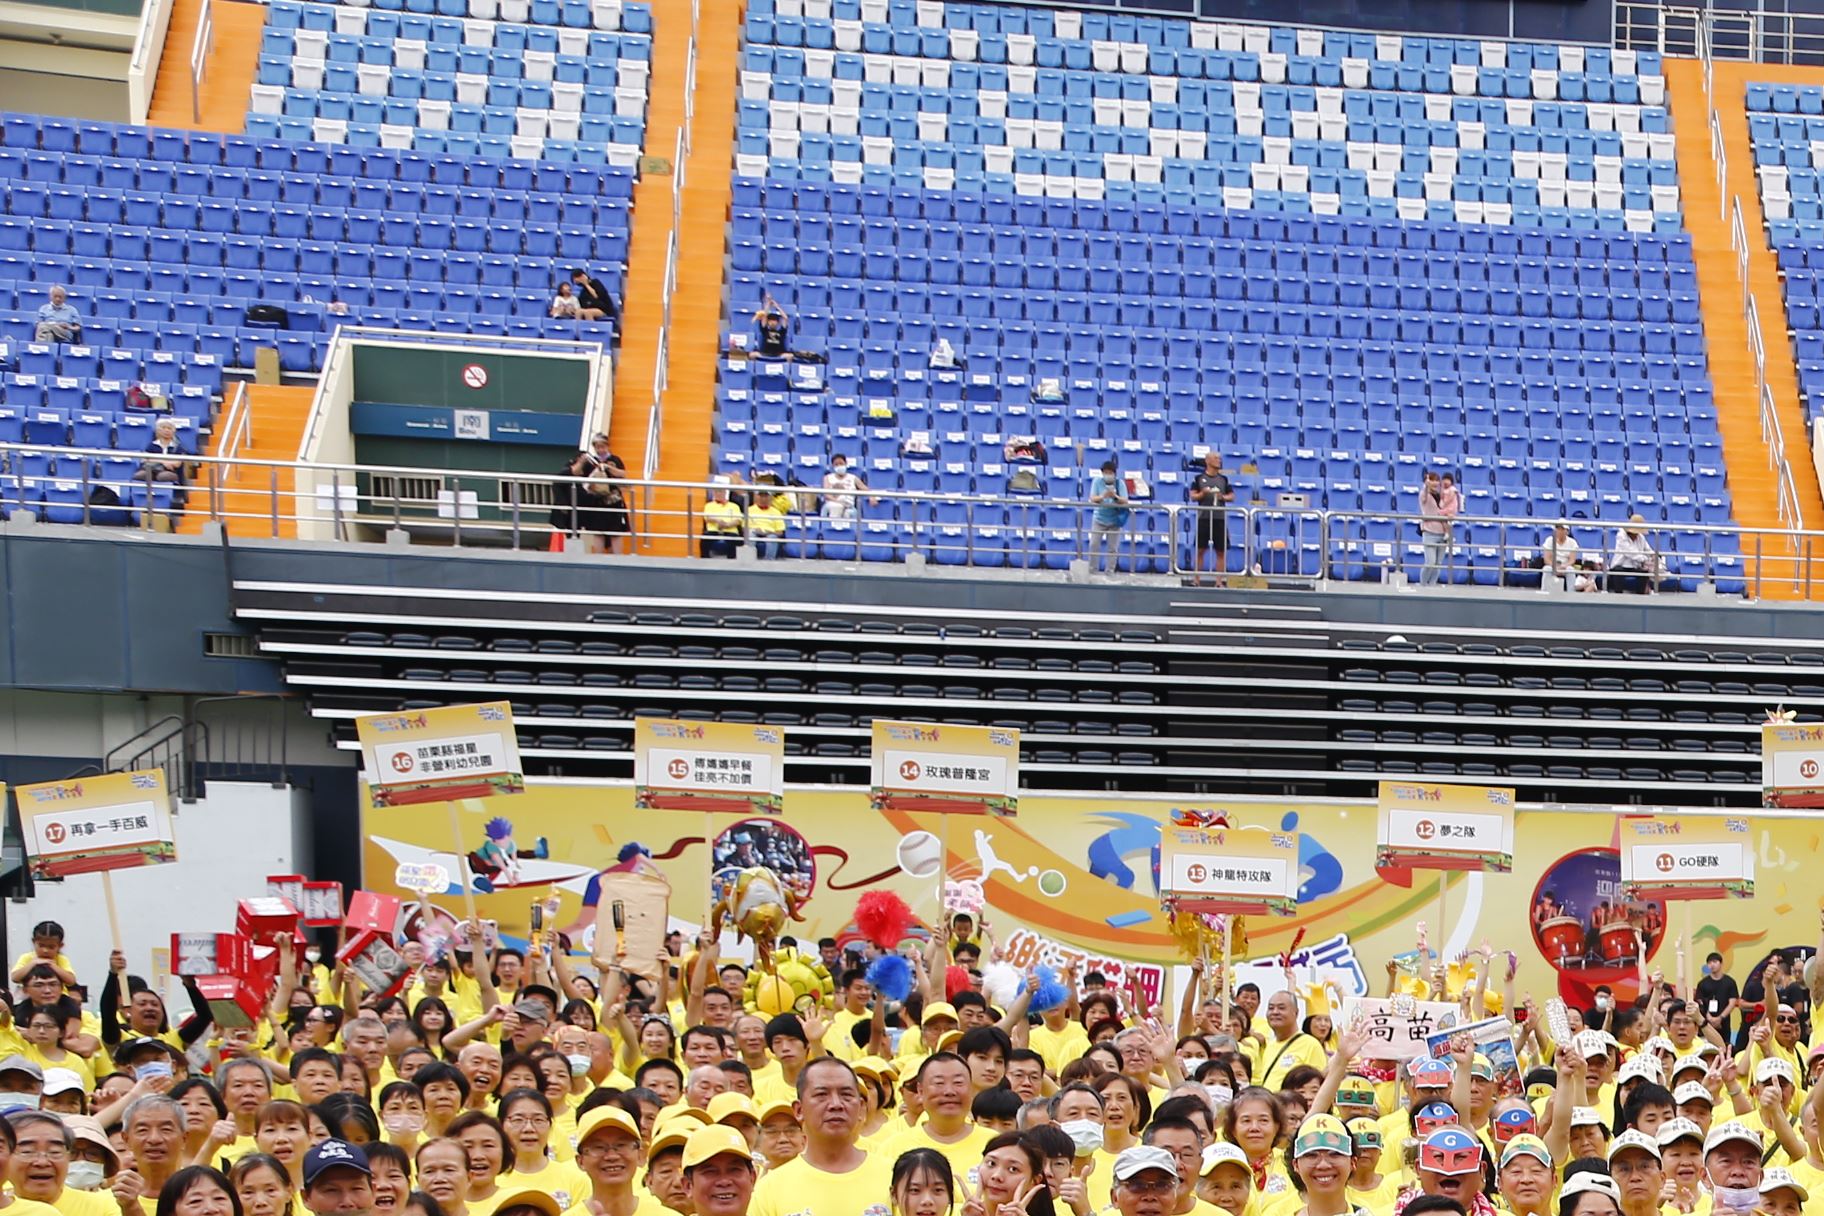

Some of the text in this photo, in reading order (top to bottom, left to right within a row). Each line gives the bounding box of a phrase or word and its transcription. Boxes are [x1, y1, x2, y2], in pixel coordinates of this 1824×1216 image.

[392, 743, 478, 770] 16 苗栗縣福星
[420, 755, 493, 773] 非營利幼兒園
[669, 763, 688, 775] 15
[902, 764, 991, 781] 14 玫瑰普隆宮
[1801, 764, 1817, 775] 10
[47, 815, 149, 840] 17 再拿一手百威
[1418, 824, 1476, 838] 12 夢之隊
[1658, 857, 1673, 869] 11
[1189, 868, 1272, 883] 13 神龍特攻隊
[1368, 1006, 1434, 1042] 高苗
